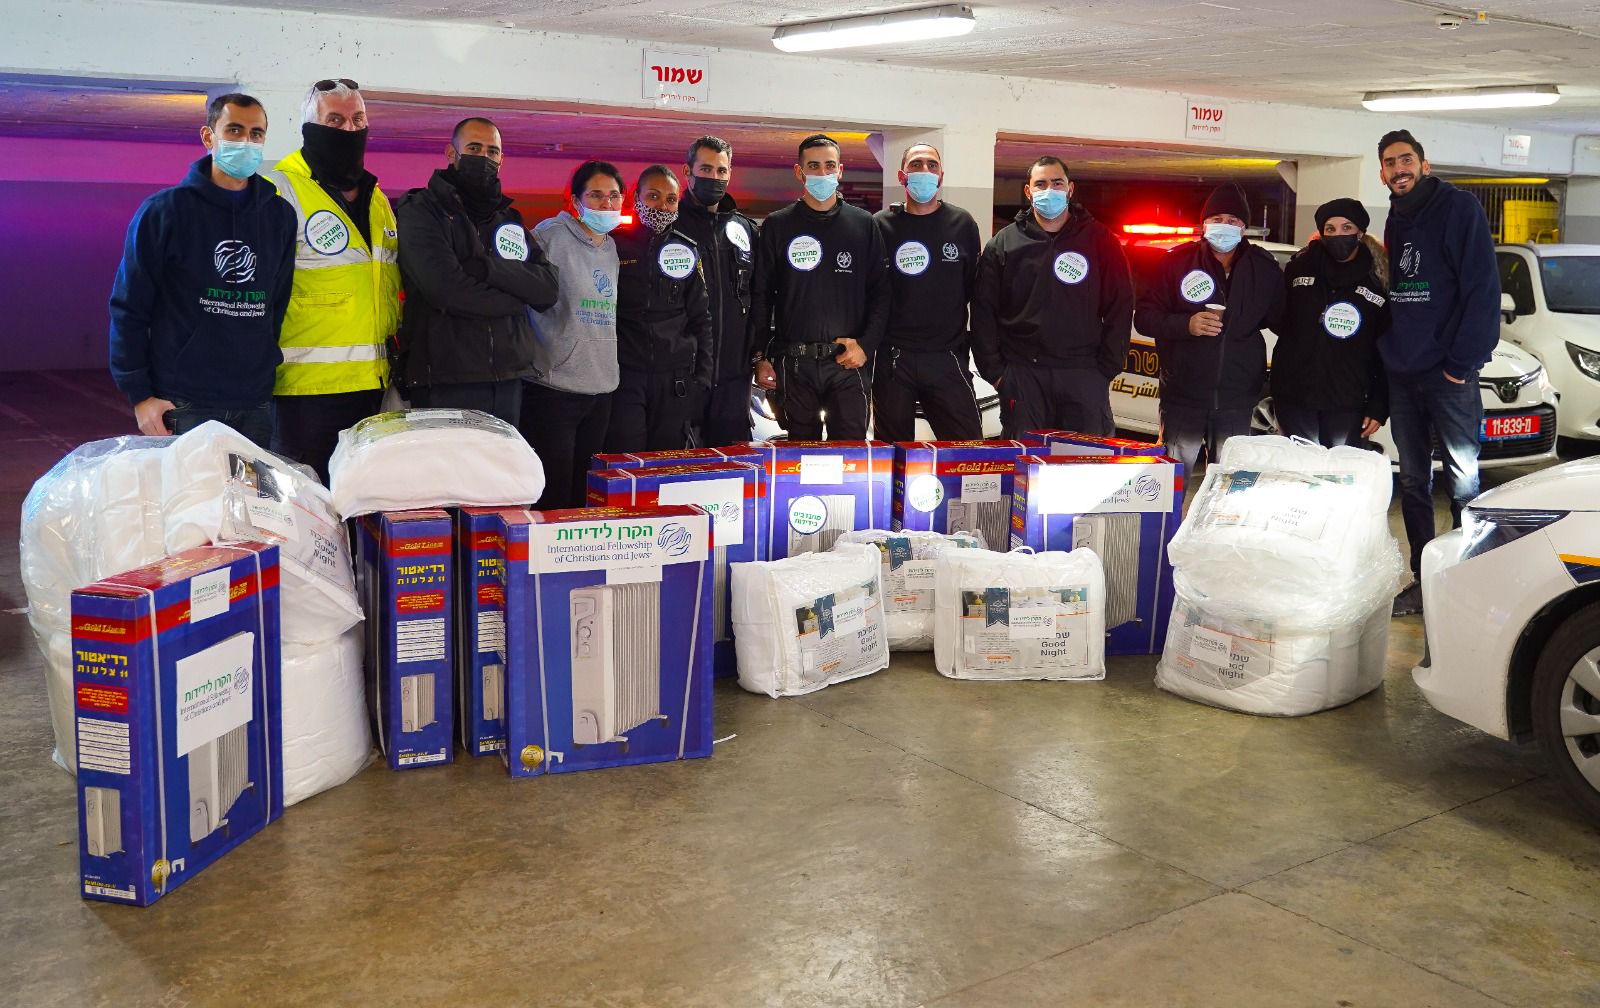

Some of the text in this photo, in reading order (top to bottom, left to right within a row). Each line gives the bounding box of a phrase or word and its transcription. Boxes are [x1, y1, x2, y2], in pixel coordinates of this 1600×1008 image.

[650, 65, 703, 84] שמור
[1191, 106, 1223, 122] שמור
[956, 462, 981, 473] Gold
[982, 462, 1004, 473] Line
[556, 522, 653, 541] הקרן לידידות
[314, 540, 336, 558] Good
[547, 540, 653, 554] International Fellowship
[313, 551, 337, 568] Night
[554, 553, 565, 564] of
[565, 551, 611, 563] Christians
[611, 550, 630, 561] and
[396, 563, 445, 576] רדיאטור
[861, 641, 878, 654] Night
[1041, 640, 1066, 648] Good
[75, 650, 128, 666] רדיאטור
[1040, 648, 1067, 657] Night
[1230, 653, 1249, 663] שמי
[1218, 668, 1244, 679] Night
[184, 673, 232, 703] הקרן לידידות
